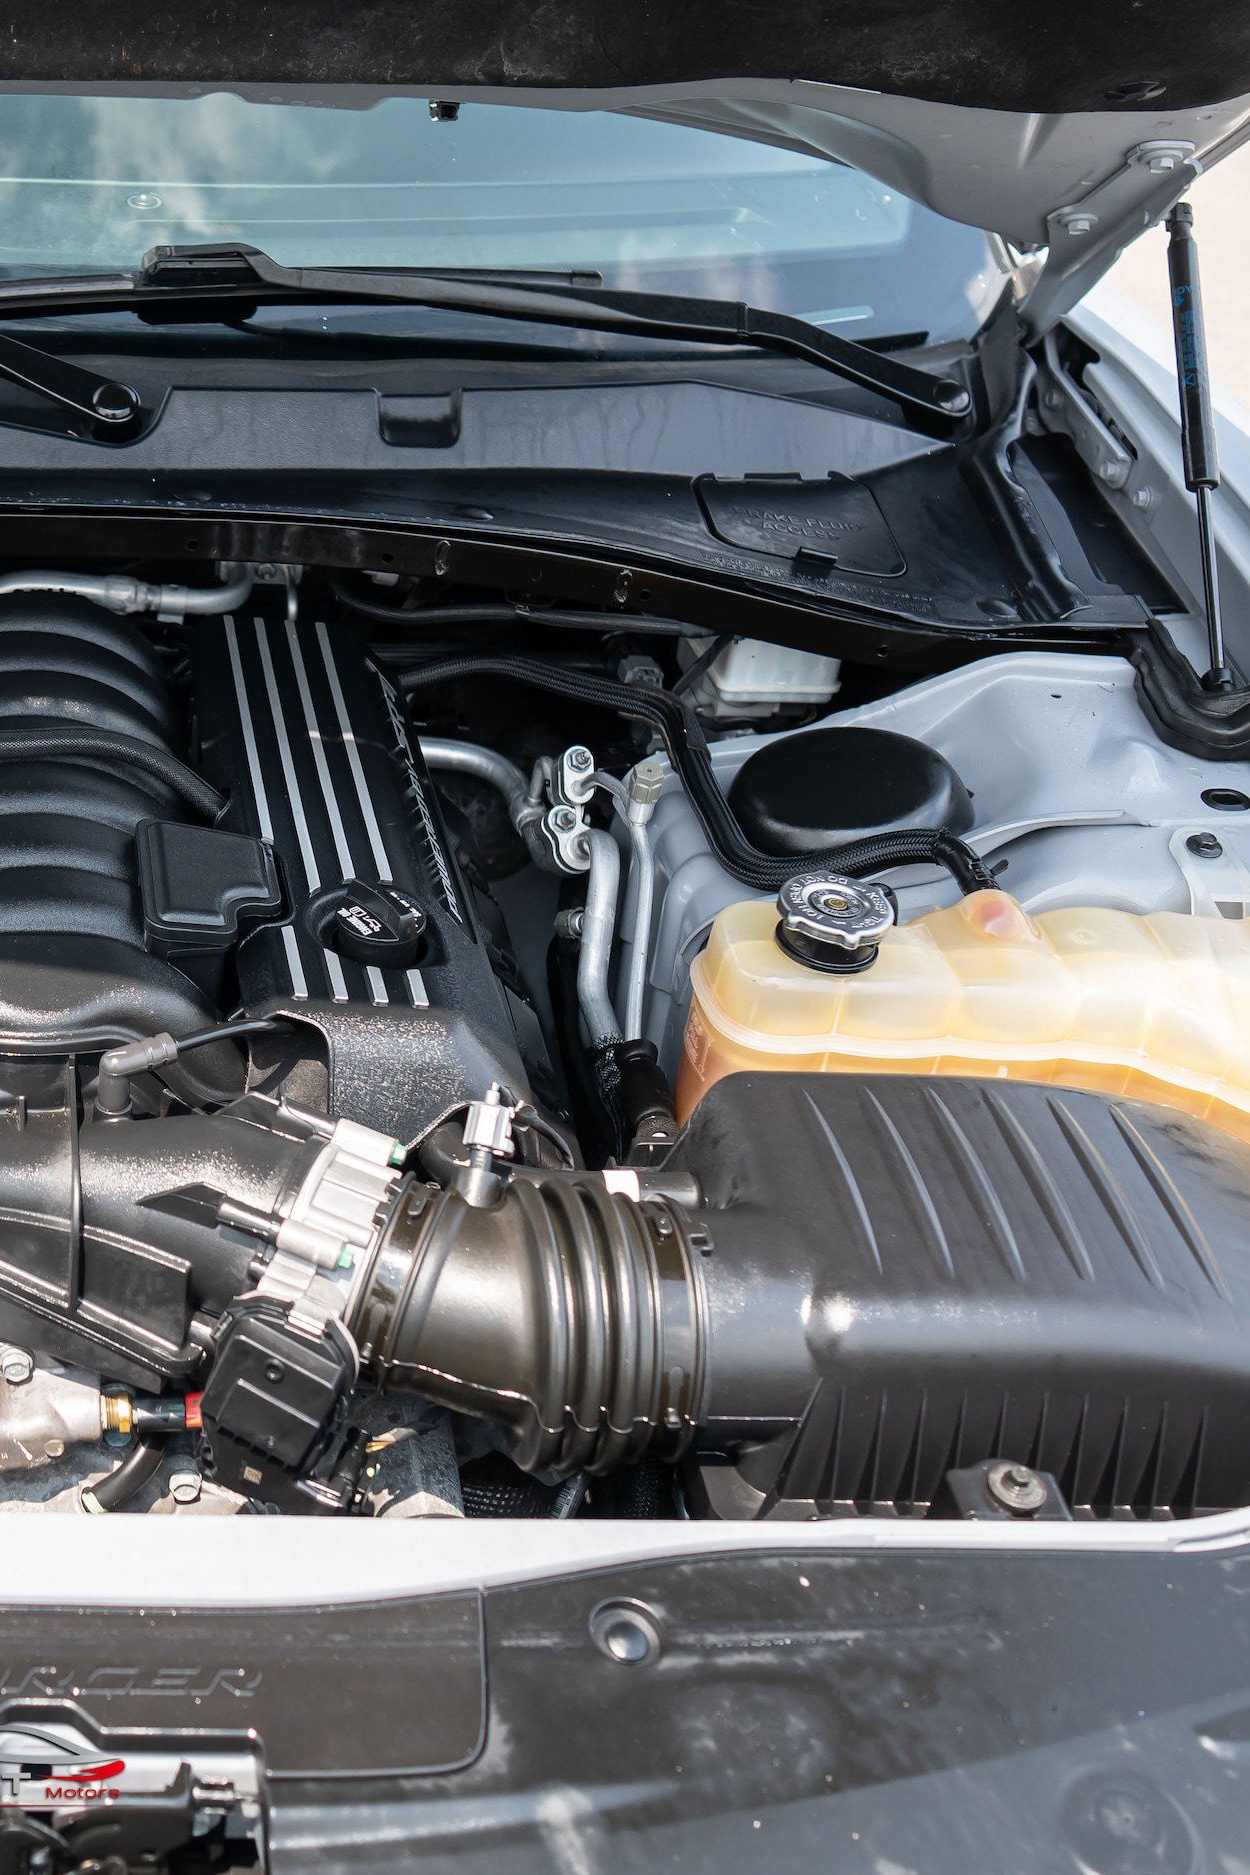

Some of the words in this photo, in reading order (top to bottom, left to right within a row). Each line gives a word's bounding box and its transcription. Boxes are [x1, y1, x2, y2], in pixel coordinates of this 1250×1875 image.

[732, 505, 802, 525] BRAKE
[762, 520, 841, 541] ACCESS
[800, 875, 826, 886] NOT
[827, 875, 848, 885] DO
[336, 906, 352, 918] OIL
[798, 905, 824, 920] HOT
[347, 915, 374, 936] ENGINE
